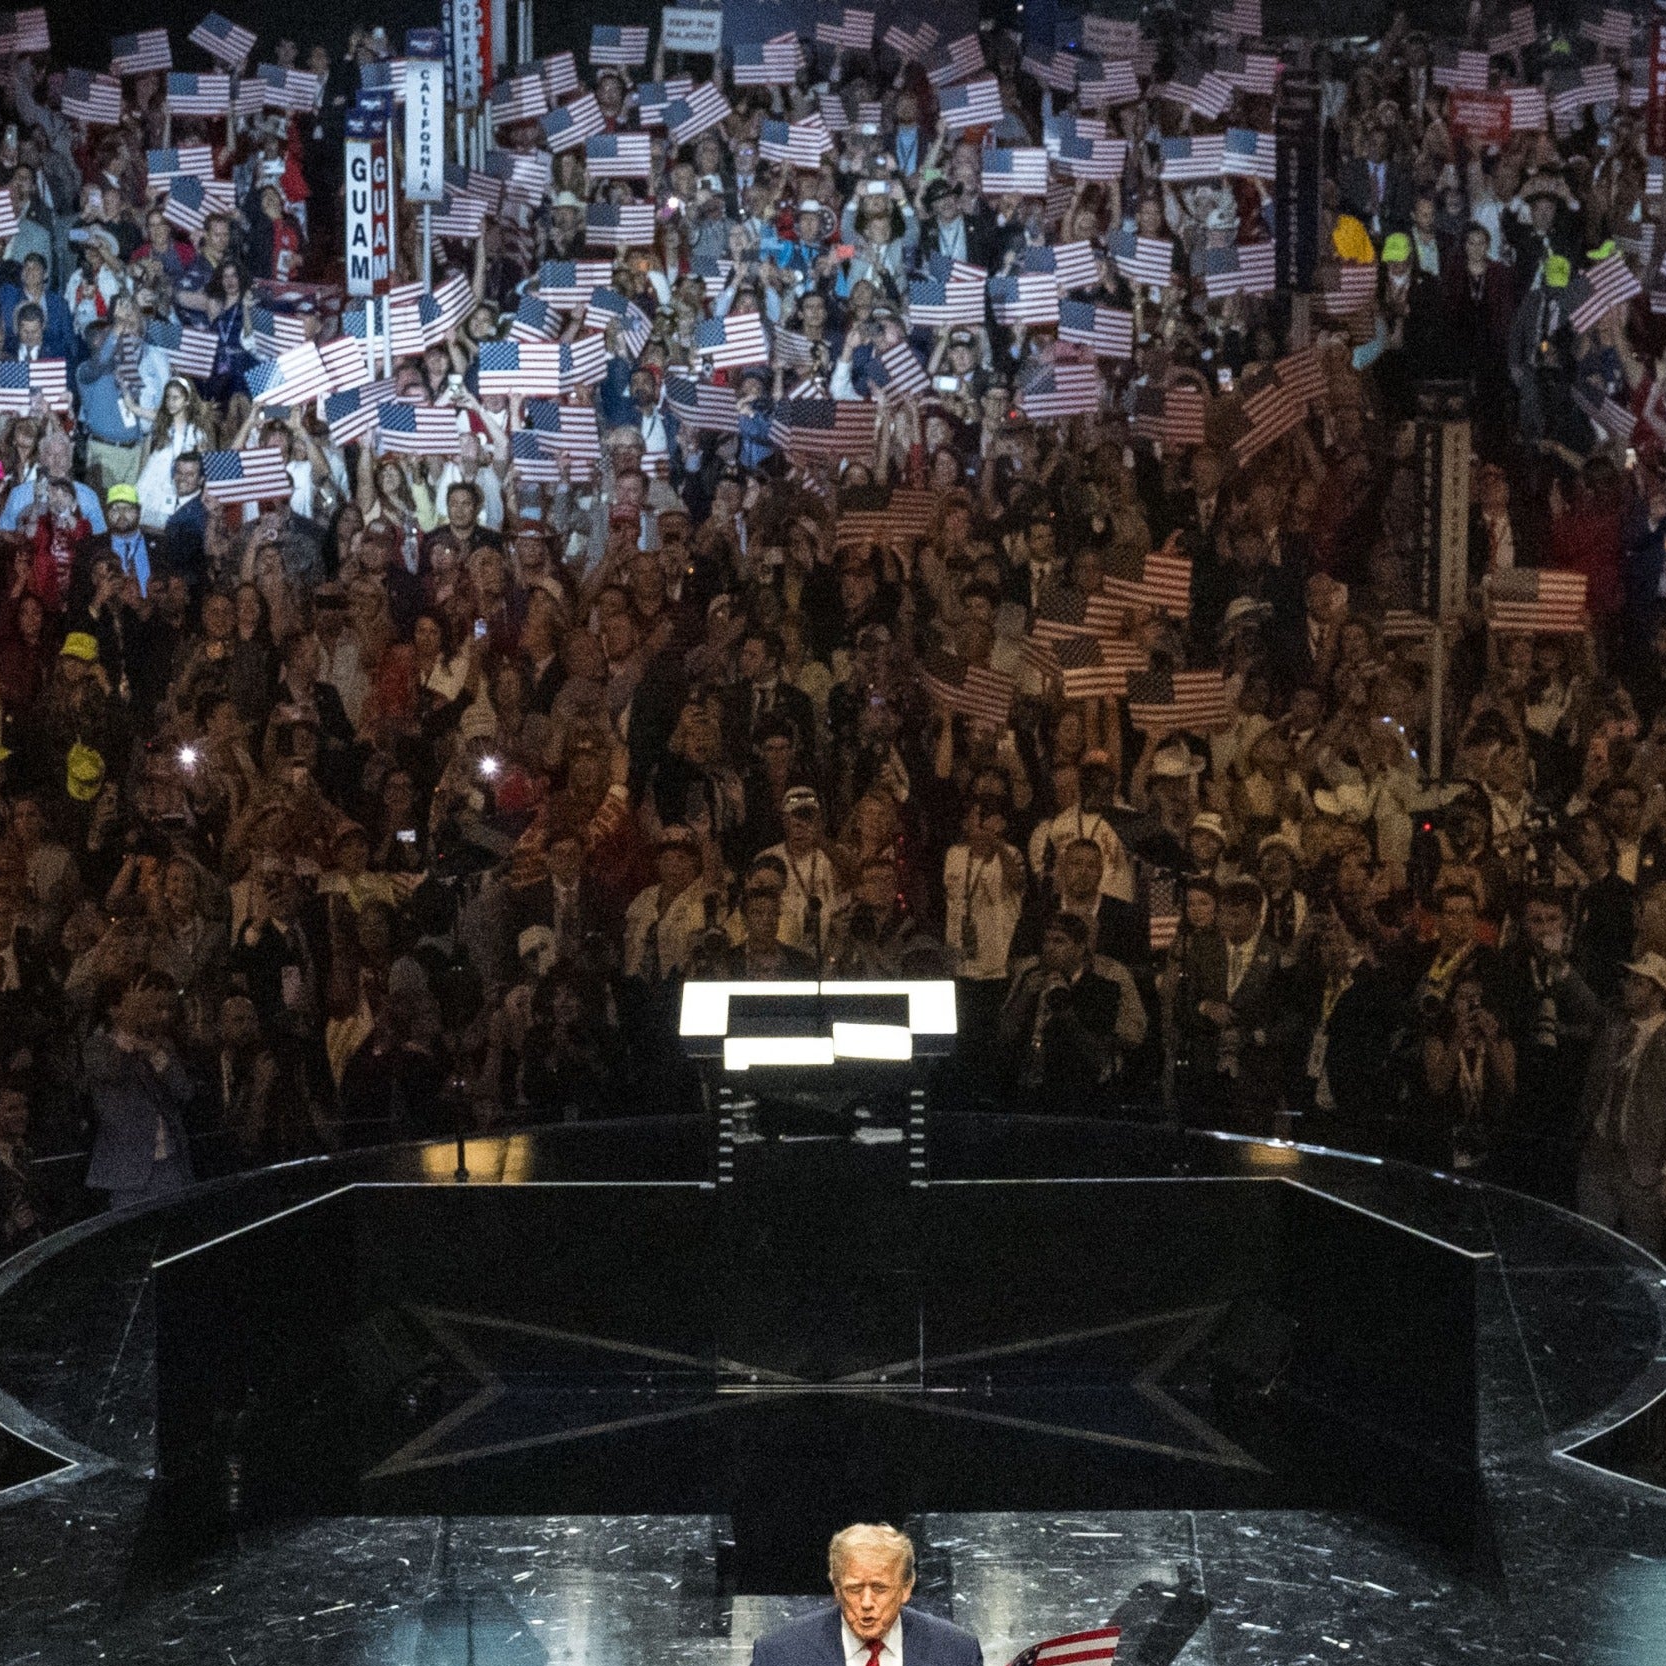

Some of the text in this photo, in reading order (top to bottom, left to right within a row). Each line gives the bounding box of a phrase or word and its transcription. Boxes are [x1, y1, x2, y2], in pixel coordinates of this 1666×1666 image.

[420, 69, 432, 193] CALIFORNIA
[351, 157, 370, 280] GUAM
[374, 155, 389, 280] GUAM
